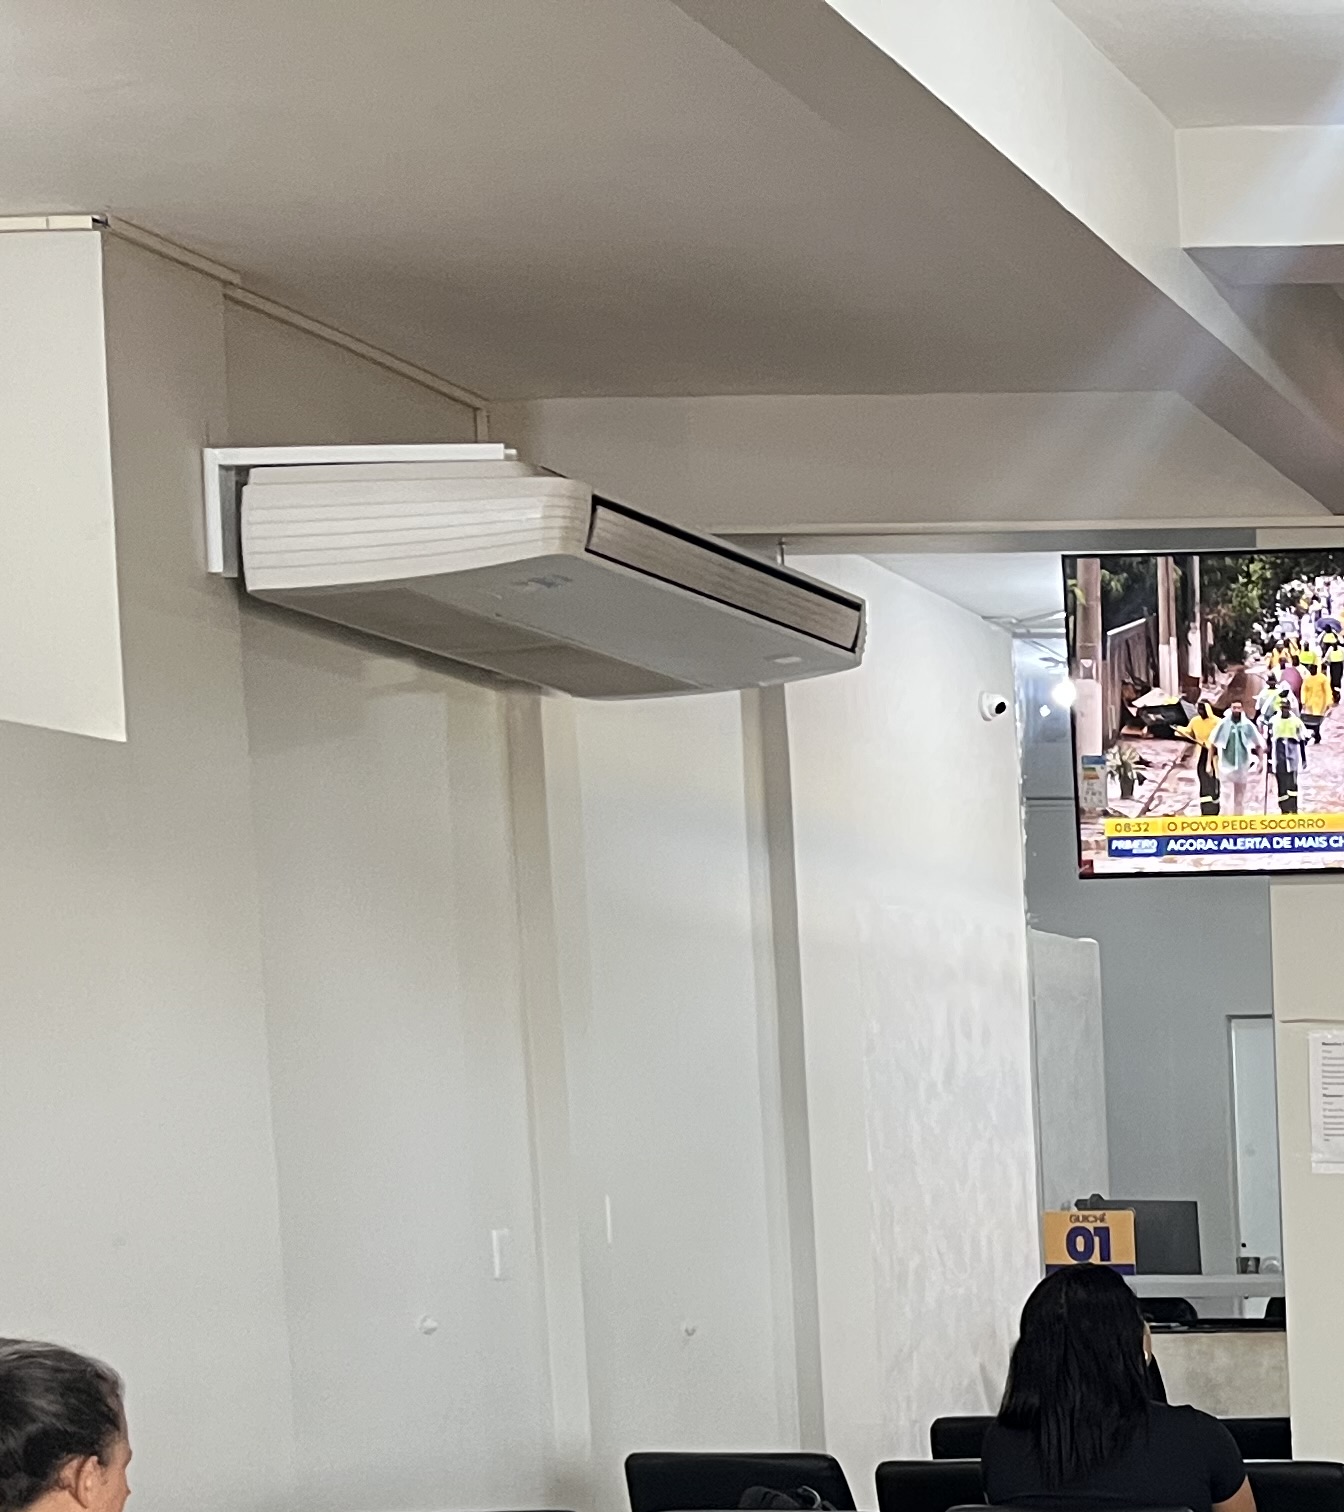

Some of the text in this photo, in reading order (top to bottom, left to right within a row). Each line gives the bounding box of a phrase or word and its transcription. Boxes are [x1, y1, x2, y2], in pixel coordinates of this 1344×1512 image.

[1114, 822, 1150, 833] 08:32
[1167, 818, 1326, 832] O POVO PEDE SOCORRO
[1166, 838, 1219, 851] AGORA:
[1219, 837, 1271, 850] ALERTA
[1273, 837, 1292, 849] DE
[1294, 836, 1328, 849] MAIS
[1069, 1212, 1107, 1224] GUICHÊ
[1065, 1225, 1112, 1262] 01
